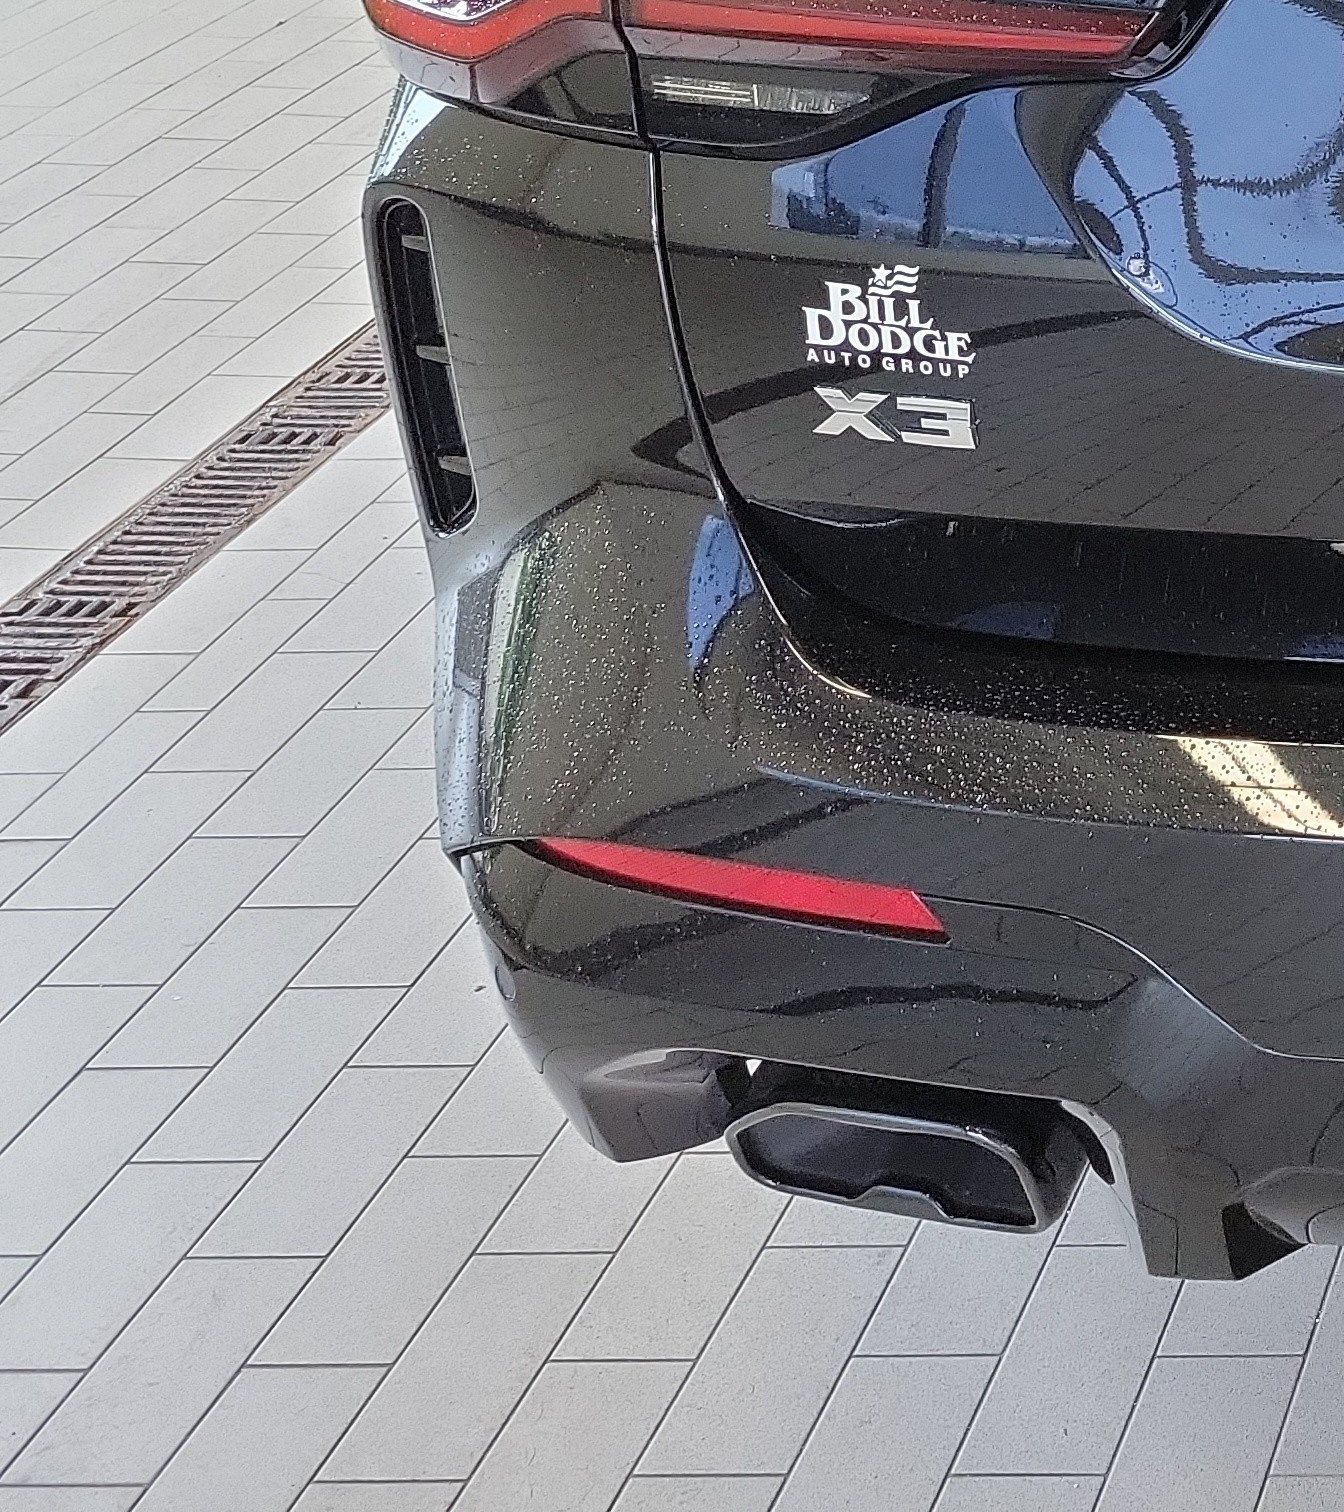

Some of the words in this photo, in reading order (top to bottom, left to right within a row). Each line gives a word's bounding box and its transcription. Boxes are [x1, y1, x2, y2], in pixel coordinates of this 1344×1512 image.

[824, 280, 934, 330] BILL
[801, 306, 977, 365] DODGE
[806, 348, 871, 369] AUTO
[881, 358, 971, 379] GROUP
[812, 385, 981, 451] X3
